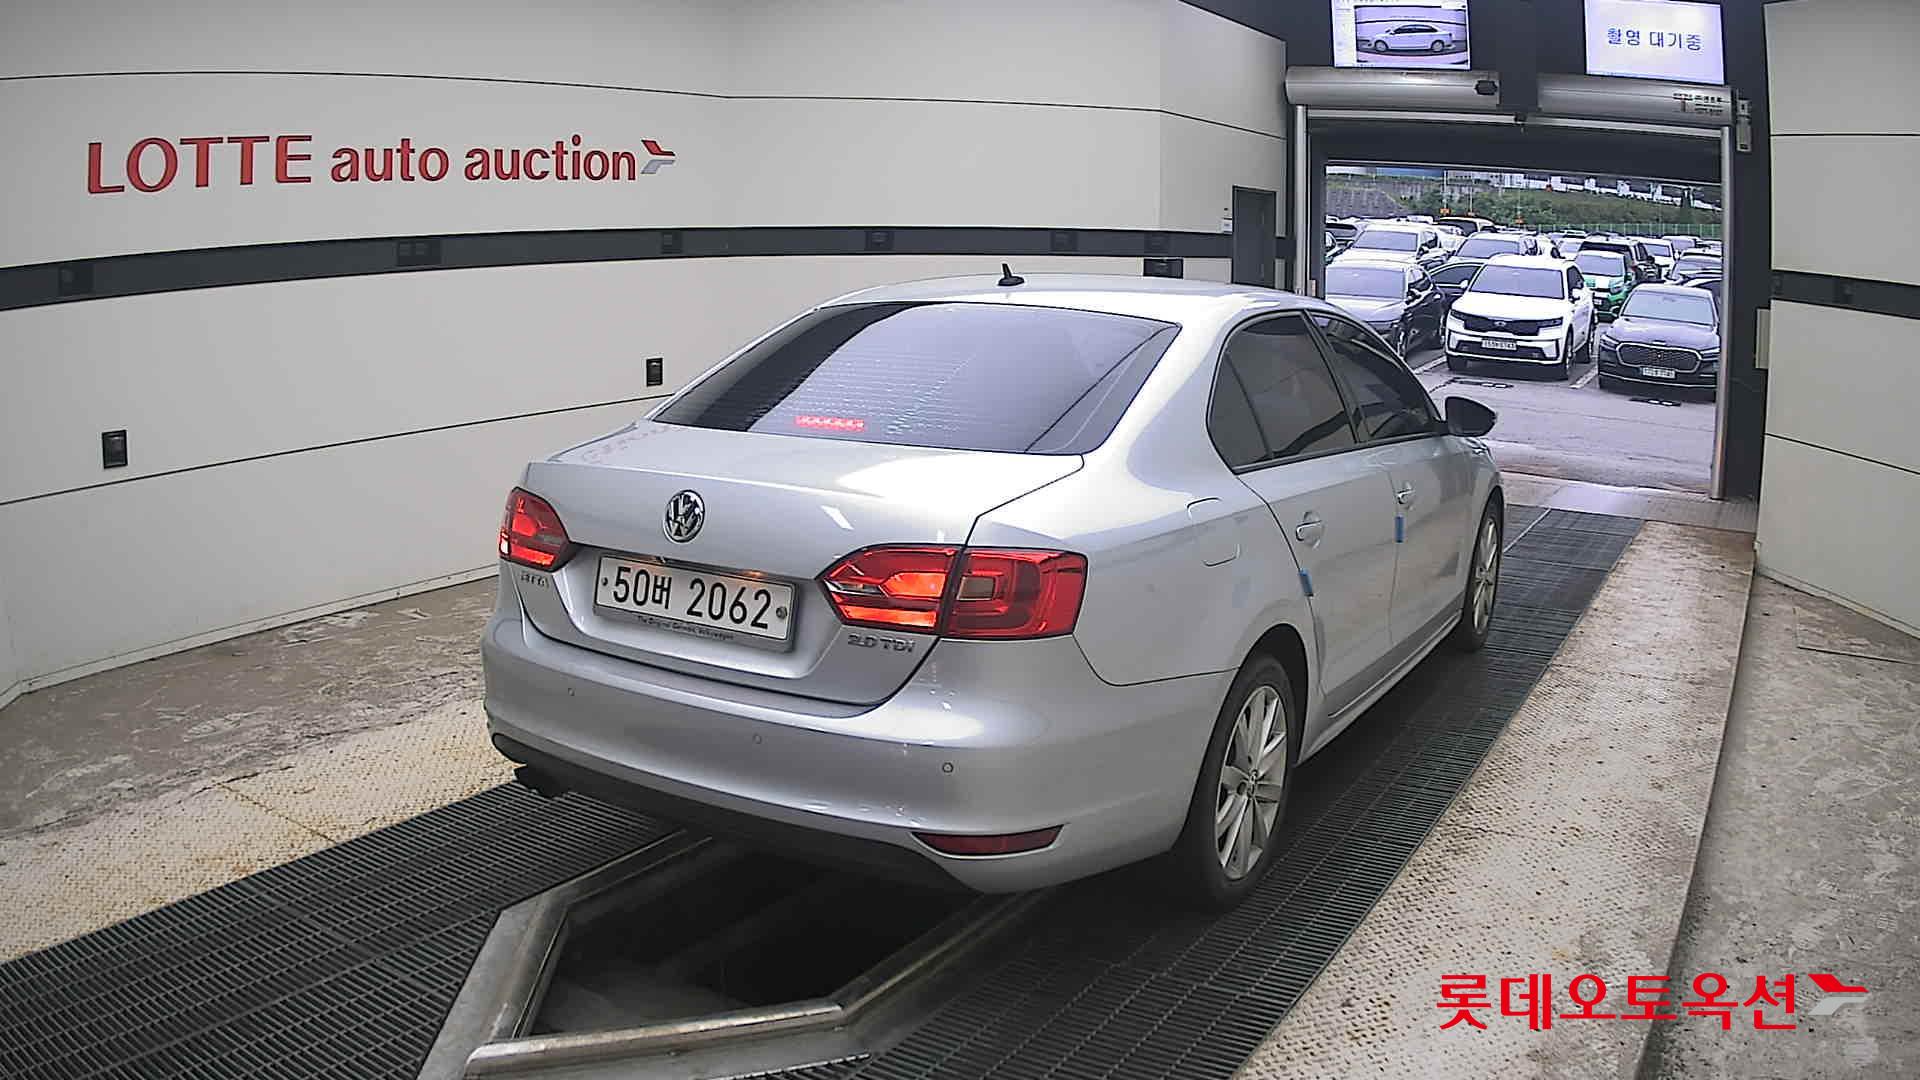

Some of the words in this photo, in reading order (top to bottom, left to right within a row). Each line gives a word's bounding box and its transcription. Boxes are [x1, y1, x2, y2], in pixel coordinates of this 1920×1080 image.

[1649, 30, 1702, 52] 대기중
[87, 134, 313, 195] LOTTE
[330, 137, 450, 184] auto
[464, 134, 637, 183] auction
[612, 565, 672, 610] 50버
[686, 577, 772, 630] 2062
